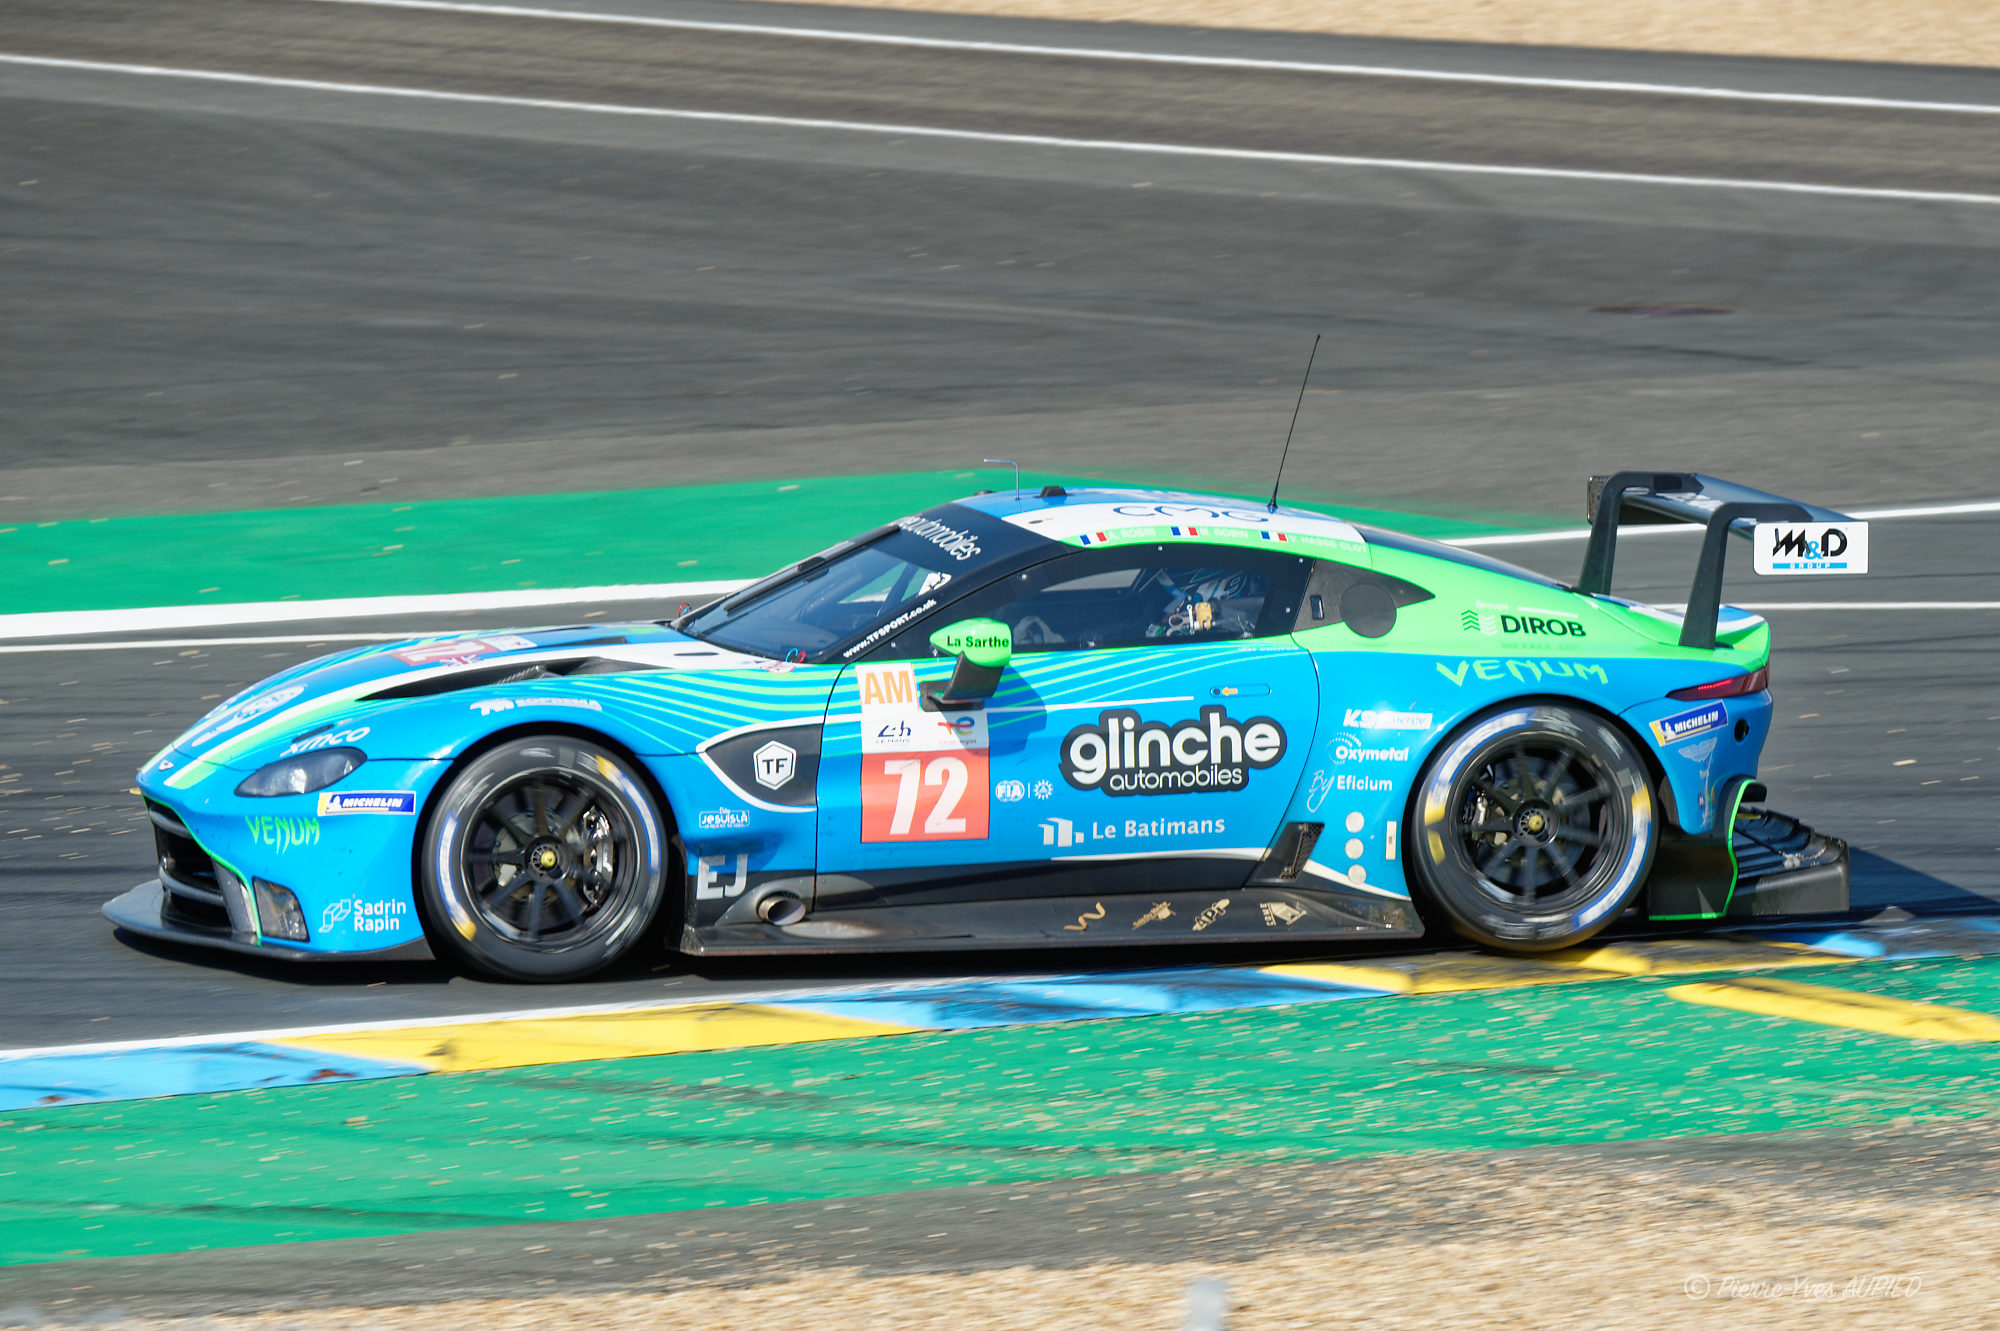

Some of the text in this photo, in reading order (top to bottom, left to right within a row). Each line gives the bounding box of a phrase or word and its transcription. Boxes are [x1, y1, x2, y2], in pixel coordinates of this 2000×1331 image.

[1120, 527, 1156, 539] ROBIN
[1213, 527, 1248, 538] ROBIN
[1773, 528, 1847, 560] M&D
[1500, 614, 1587, 637] DIROB
[947, 636, 1009, 648] La Sarthe
[1436, 659, 1609, 687] VENUM
[864, 670, 913, 705] AM
[1674, 710, 1719, 734] MICHELIN
[1069, 712, 1281, 786] glinche
[1335, 745, 1409, 763] Oxymetal
[762, 757, 788, 774] TF
[1109, 765, 1243, 791] automobiles
[342, 796, 404, 808] MICHELIN
[884, 756, 968, 835] 72
[1306, 769, 1393, 813] By Eficium
[245, 816, 320, 854] VENUM
[1093, 818, 1225, 839] Le Batimans
[696, 853, 748, 900] EJ
[354, 898, 406, 916] Sadrin
[354, 915, 400, 933] Rapin
